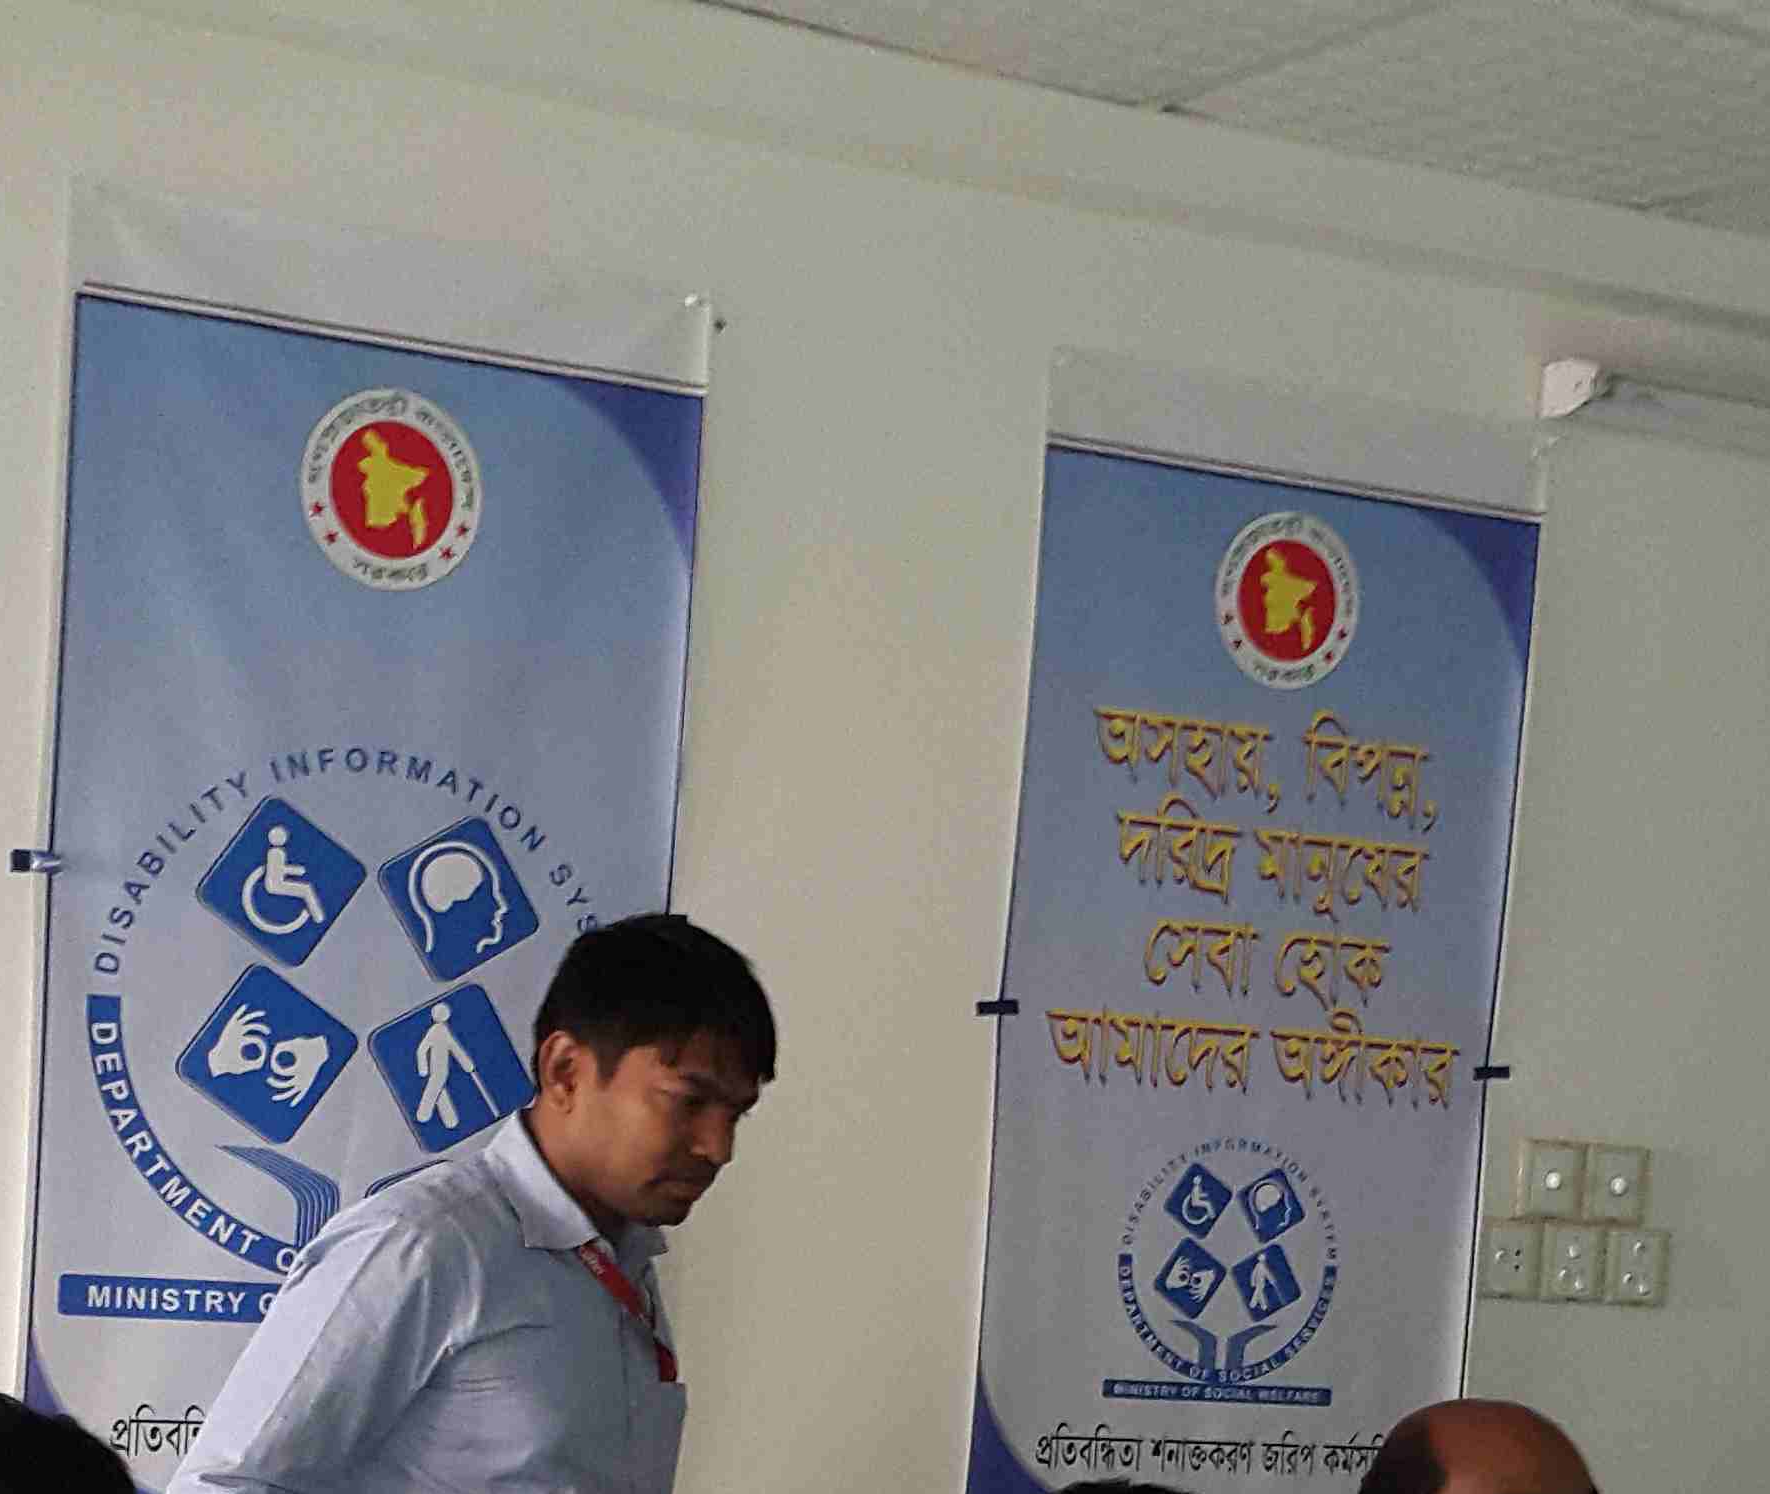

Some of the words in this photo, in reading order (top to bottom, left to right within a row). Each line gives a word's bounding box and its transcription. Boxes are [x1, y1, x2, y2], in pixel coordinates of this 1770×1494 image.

[1094, 706, 1279, 814] অসহায়,
[1303, 708, 1437, 833] বিপন্ন,
[94, 771, 248, 974] DISABILITY
[270, 748, 547, 852] INFORMATION
[549, 864, 597, 932] SYS
[1117, 790, 1242, 905] দরিদ্র
[1254, 828, 1430, 922] মানুষের
[1145, 919, 1259, 997] সেবা
[1275, 935, 1392, 1010] হোক
[1045, 1008, 1261, 1095] আমাদের
[1270, 1008, 1461, 1110] অঙ্গীকার
[91, 1022, 260, 1256] DEPARTMENT
[276, 1247, 298, 1271] O
[88, 1285, 245, 1313] MINISTRY
[259, 1293, 277, 1314] O
[1035, 1422, 1143, 1472] প্রতিবন্ধিতা
[1151, 1439, 1254, 1474] শনাক্তকরণ
[1261, 1430, 1316, 1474] জরিপ
